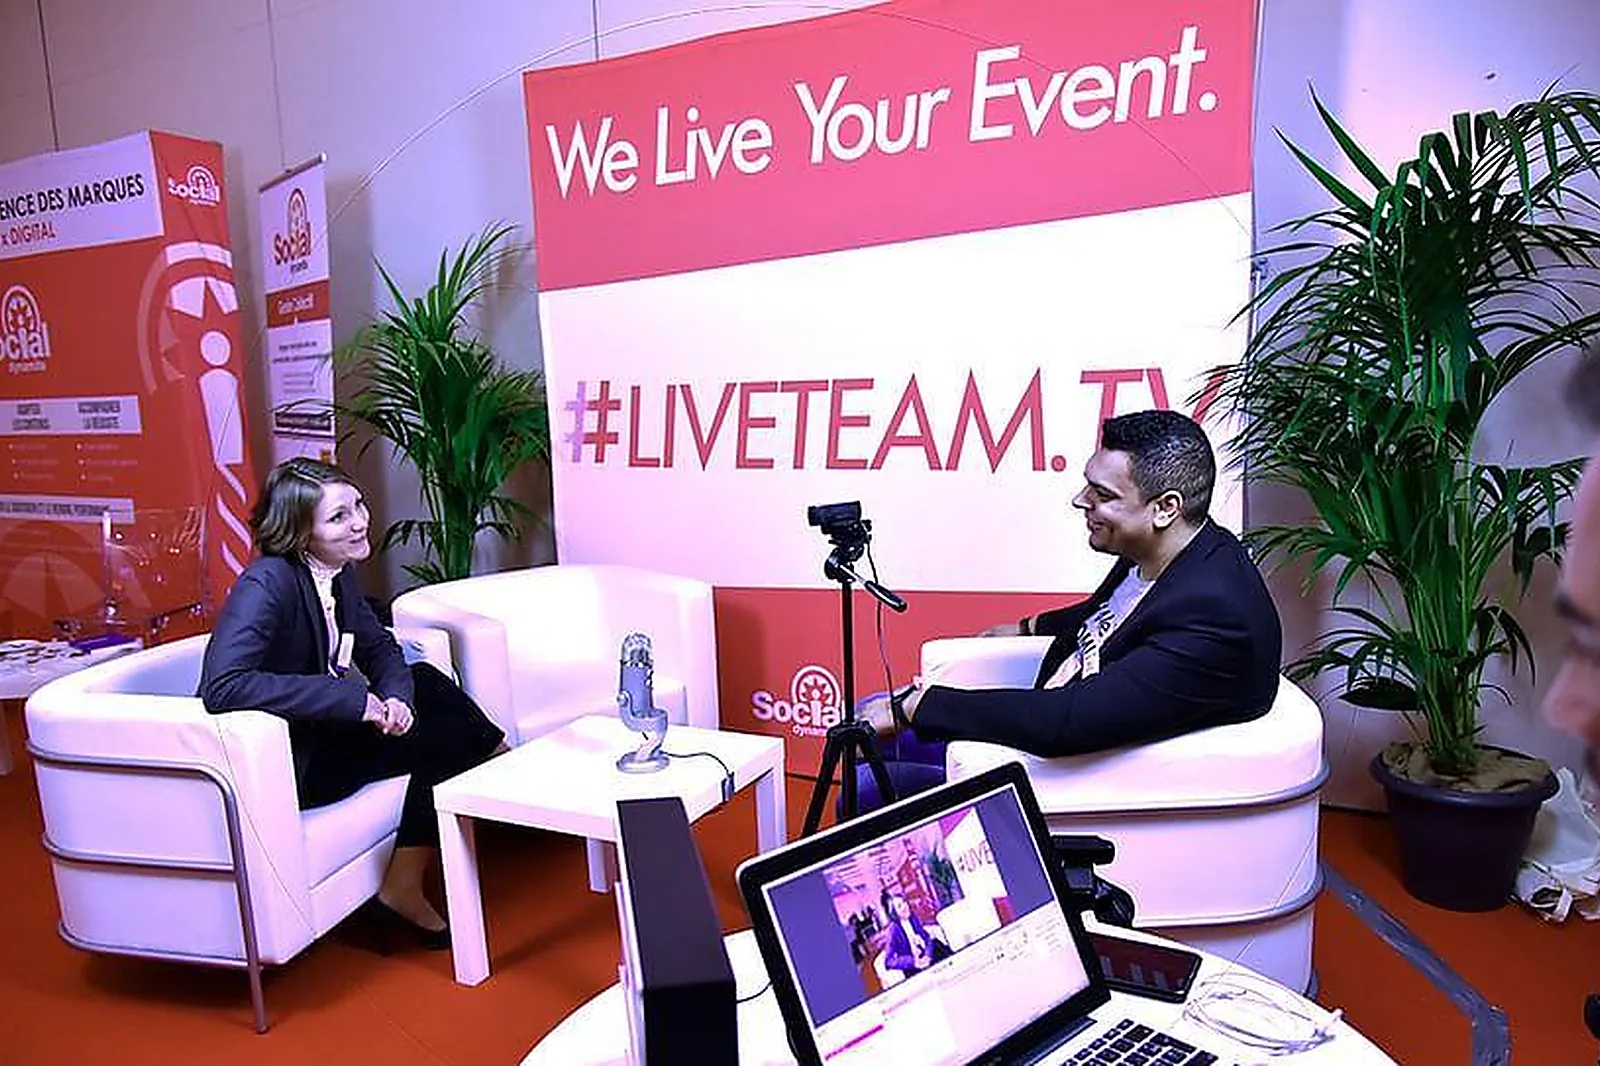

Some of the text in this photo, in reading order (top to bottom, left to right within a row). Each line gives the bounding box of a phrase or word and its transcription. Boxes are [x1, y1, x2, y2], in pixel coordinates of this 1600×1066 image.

[547, 27, 1218, 197] We Live Your Event.
[37, 188, 64, 212] DES
[67, 173, 145, 208] MARQUES
[9, 222, 56, 245] DIGITAL
